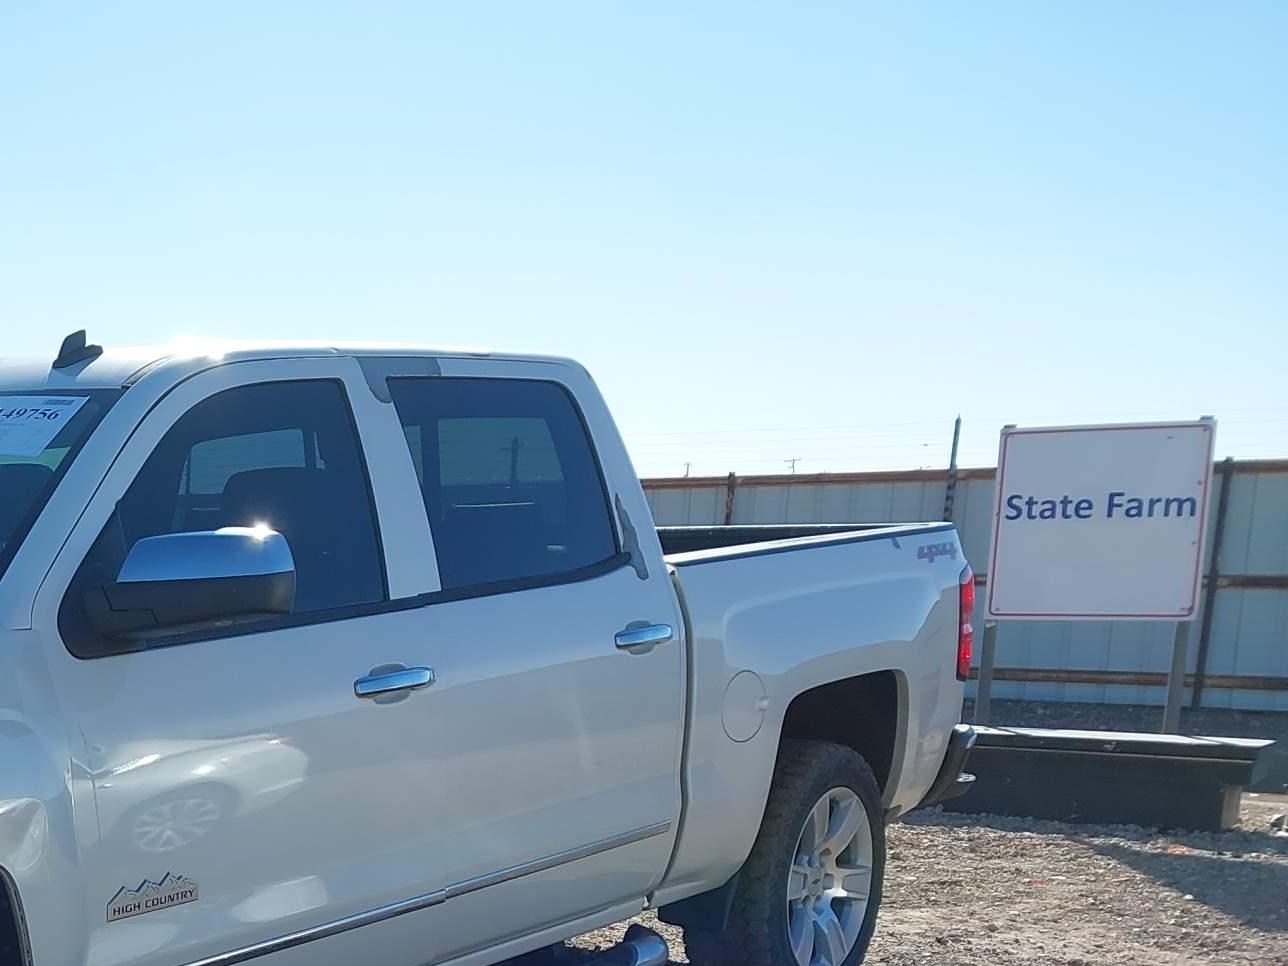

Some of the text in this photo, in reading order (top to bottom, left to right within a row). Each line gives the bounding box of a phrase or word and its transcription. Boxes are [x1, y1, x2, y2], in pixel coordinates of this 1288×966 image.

[1005, 491, 1196, 521] State Farm
[112, 889, 195, 917] HIGH COUNTRY
